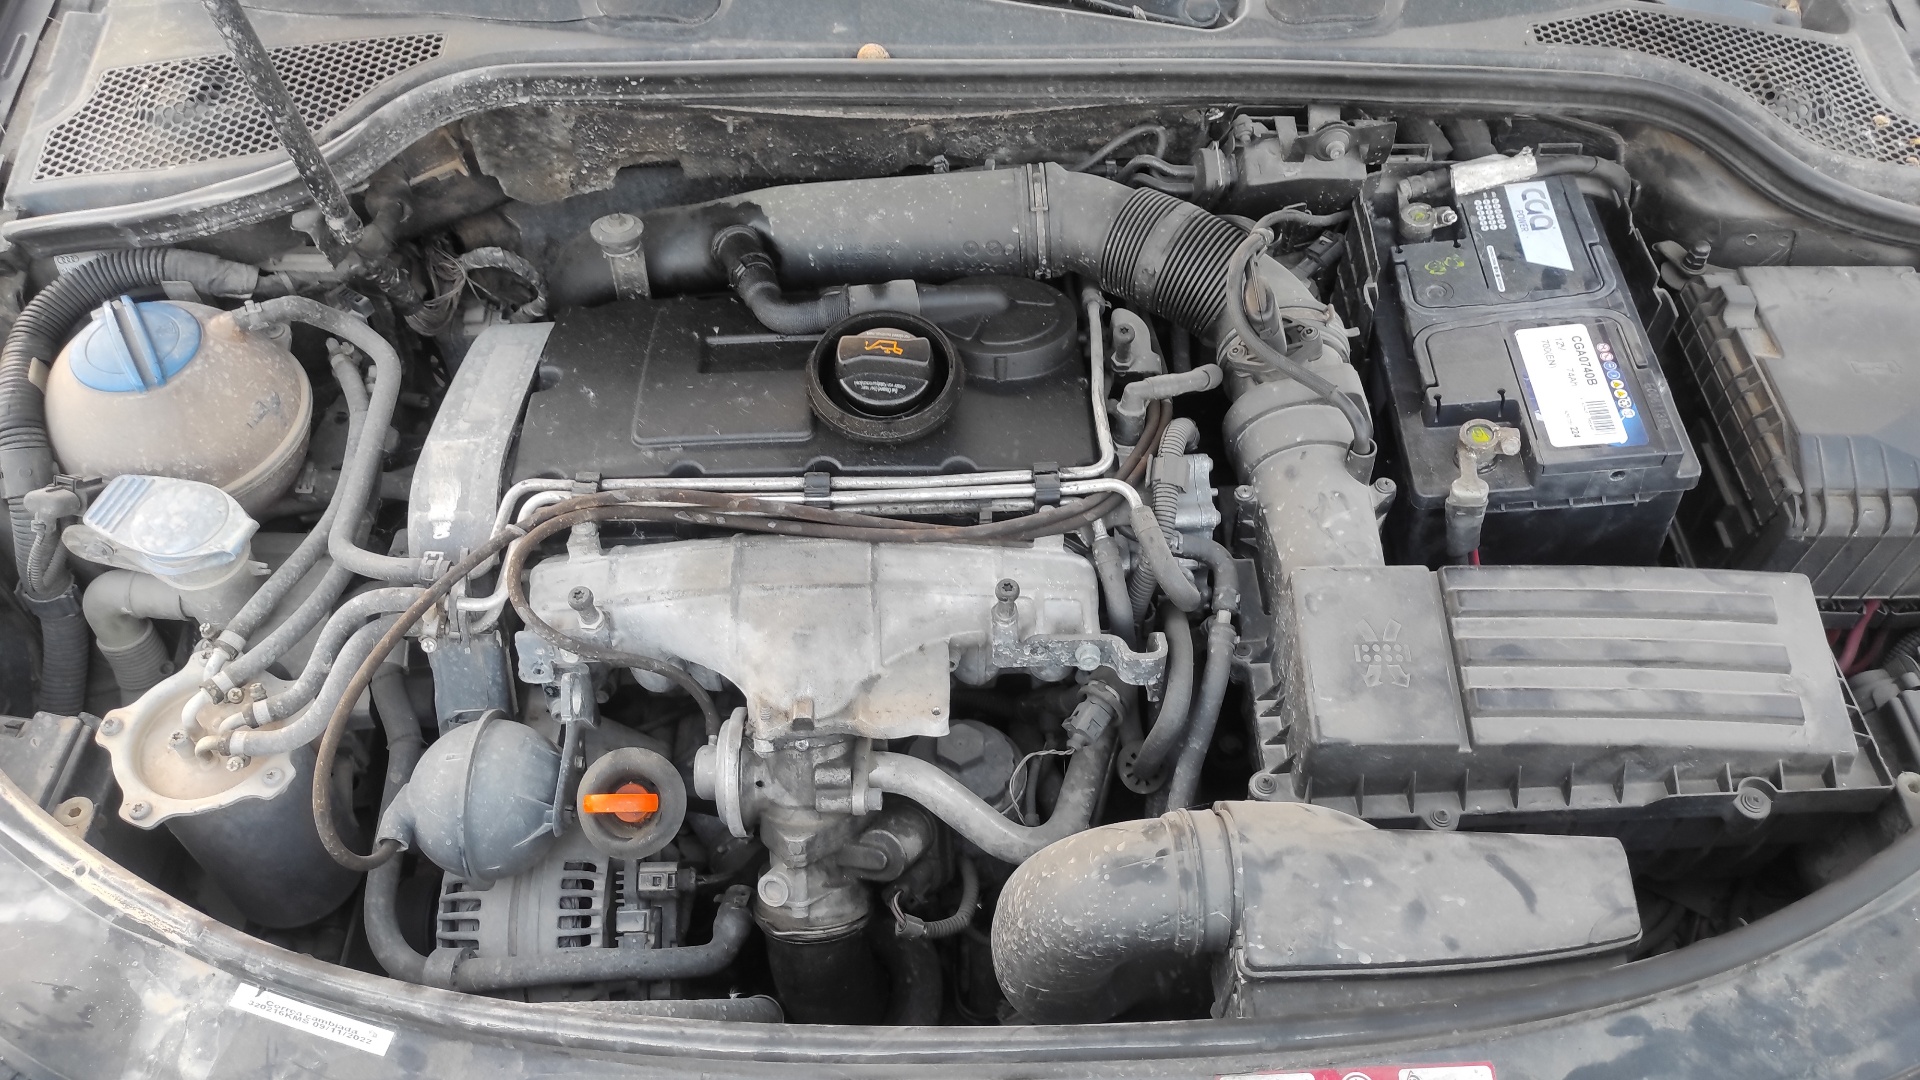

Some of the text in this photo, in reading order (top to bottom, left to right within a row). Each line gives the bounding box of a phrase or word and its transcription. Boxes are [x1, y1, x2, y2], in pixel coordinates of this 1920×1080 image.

[1515, 209, 1530, 232] POWER
[1571, 335, 1598, 386] CGA0740B
[248, 1000, 309, 1024] 320216KMS
[265, 1000, 358, 1035] Correa cambiada
